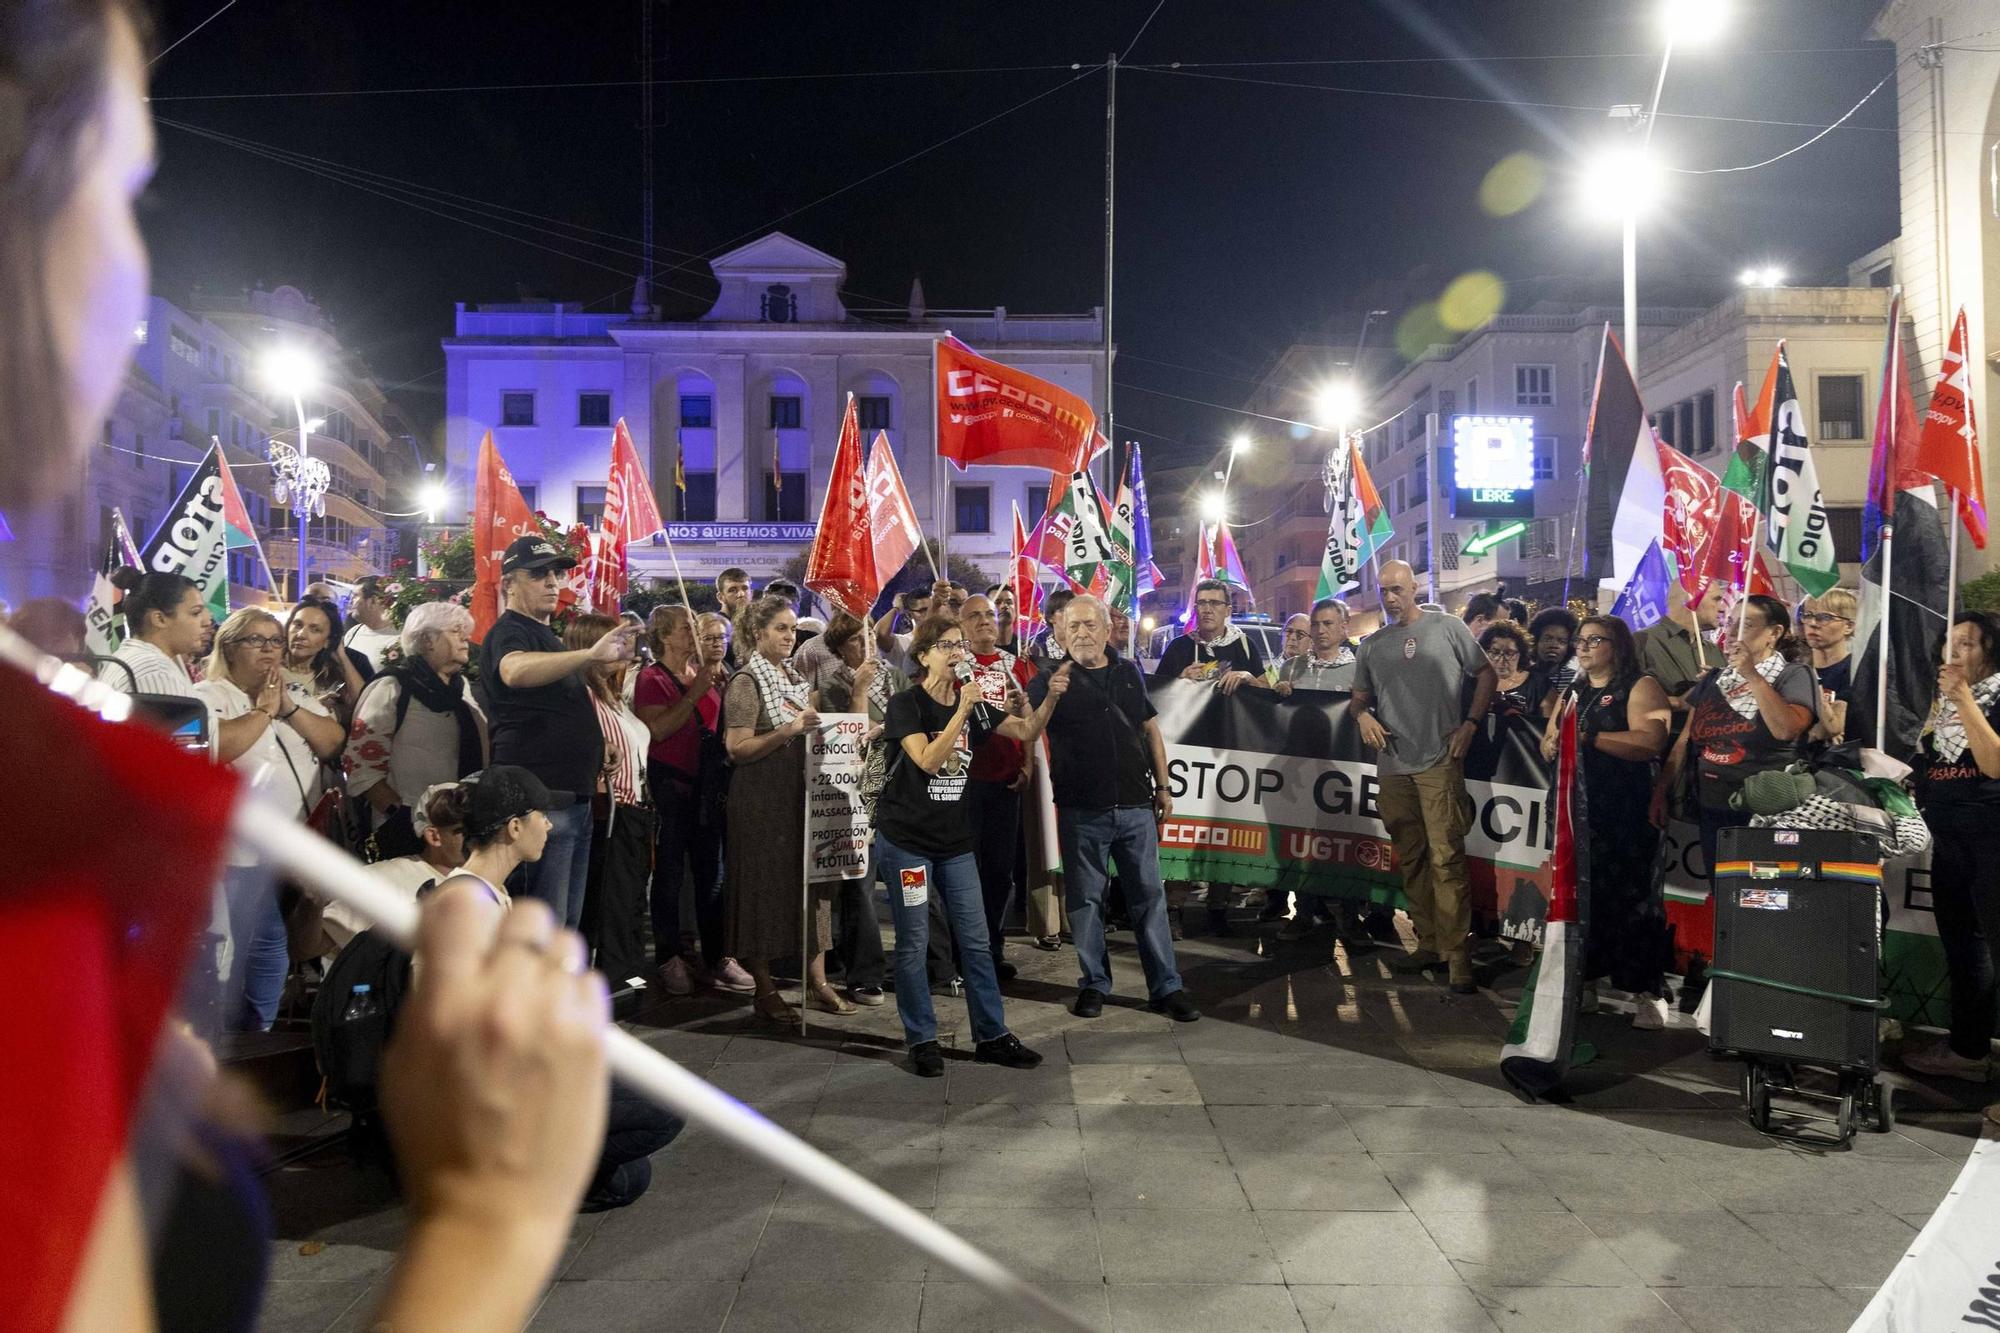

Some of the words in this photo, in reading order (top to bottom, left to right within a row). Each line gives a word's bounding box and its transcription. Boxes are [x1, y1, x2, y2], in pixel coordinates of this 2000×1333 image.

[947, 370, 1052, 414] CCOO
[1472, 488, 1515, 503] LIBRE
[668, 526, 699, 538] NOS
[702, 526, 778, 538] QUEREMOS
[781, 526, 819, 538] VIVA
[837, 722, 864, 734] STOP
[811, 773, 858, 786] +22.000
[1167, 759, 1284, 805] STOP
[811, 791, 847, 801] infants
[812, 825, 867, 840] PROTECCIÓN
[832, 839, 864, 850] SUMUD
[1162, 823, 1230, 846] CCOO
[1290, 833, 1352, 862] UGT
[816, 853, 865, 869] FLOTILLA
